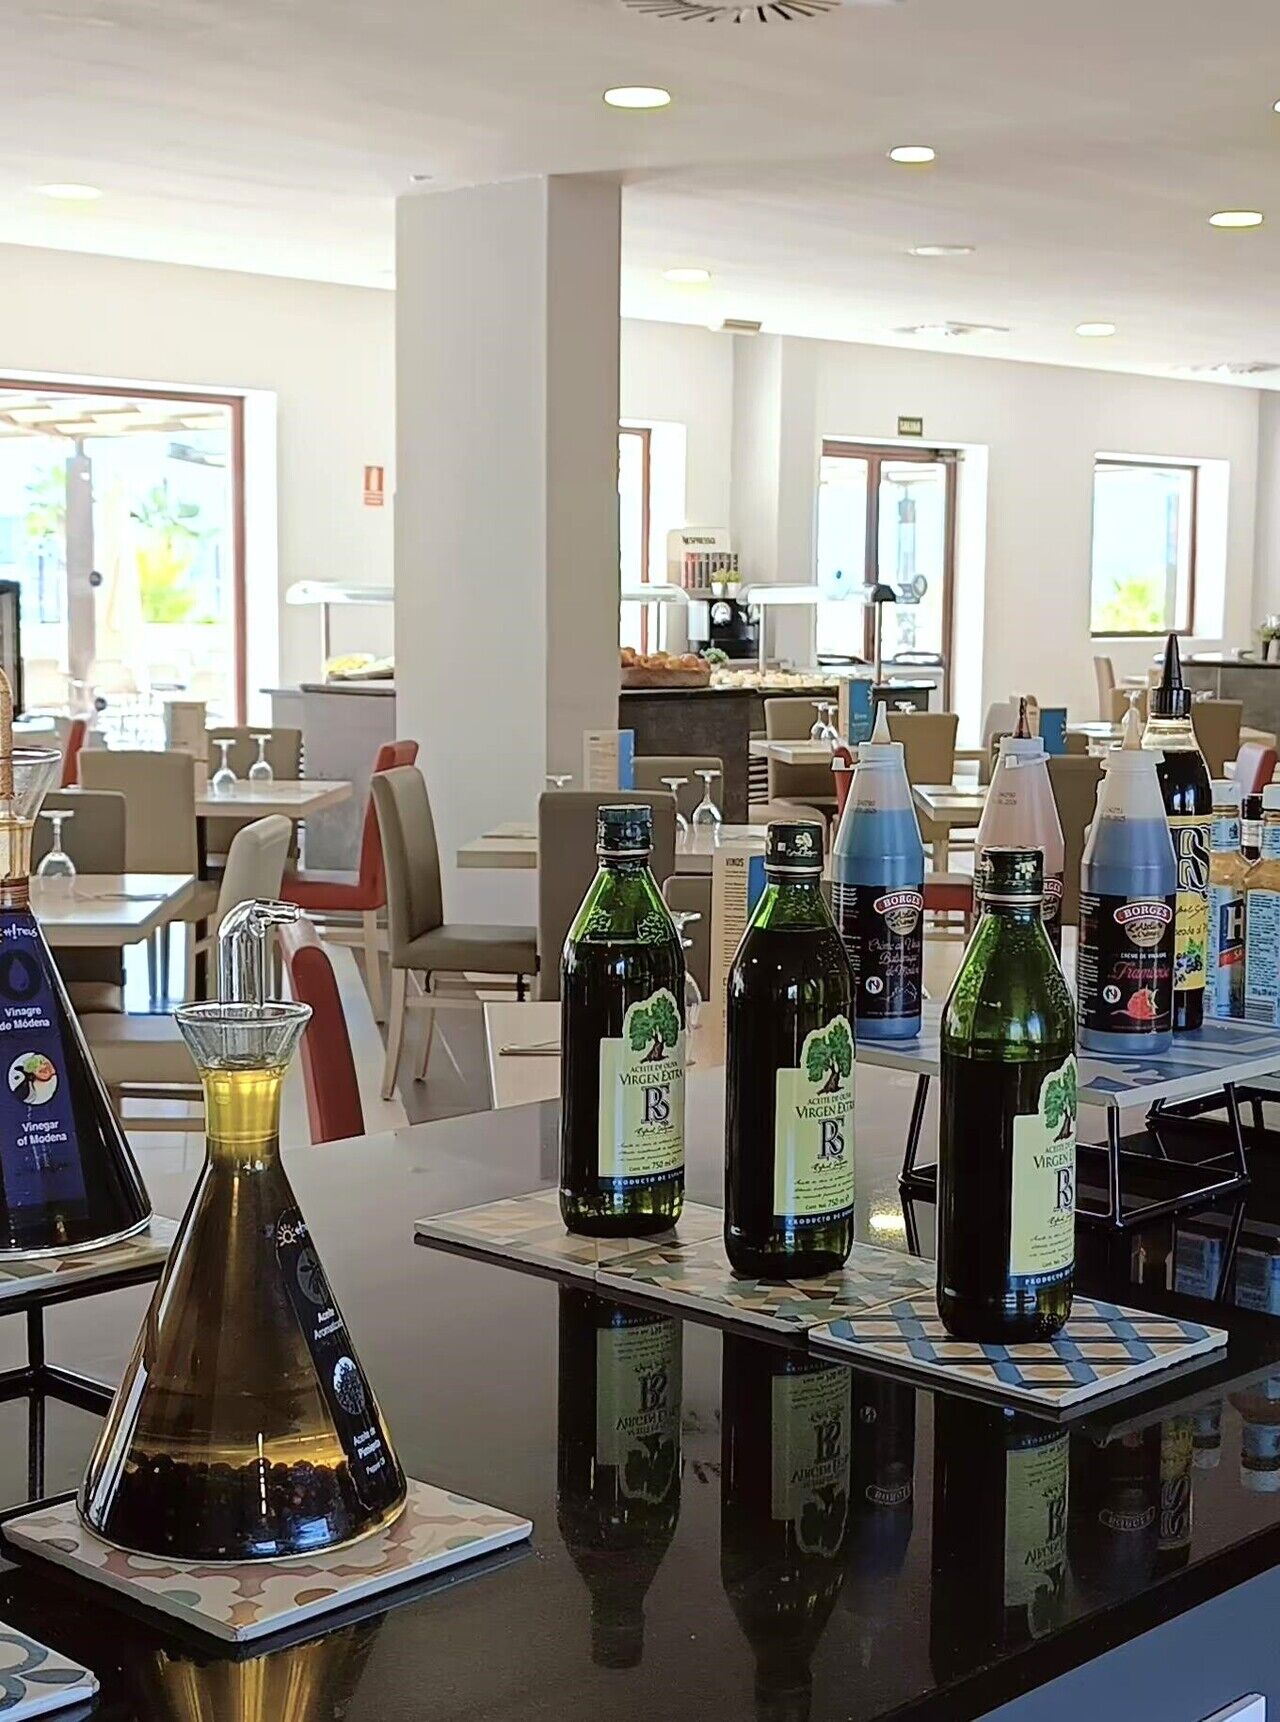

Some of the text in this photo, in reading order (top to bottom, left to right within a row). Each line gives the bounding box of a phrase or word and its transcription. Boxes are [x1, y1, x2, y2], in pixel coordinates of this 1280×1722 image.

[1043, 881, 1061, 892] RGES
[883, 895, 921, 908] BORGES
[1123, 905, 1168, 918] BORGES
[1226, 906, 1244, 941] H
[4, 1006, 42, 1018] Vinagre
[14, 1019, 51, 1029] Módena
[619, 1072, 660, 1085] VIRGEN
[796, 1105, 837, 1118] VIRGEN
[21, 1121, 59, 1132] Vinegar
[17, 1133, 68, 1146] of Modena
[651, 1161, 664, 1169] 750
[1033, 1153, 1068, 1169] VIRGEN
[612, 1177, 655, 1185] PRODUCTO
[1025, 1272, 1064, 1285] PRODUCTO
